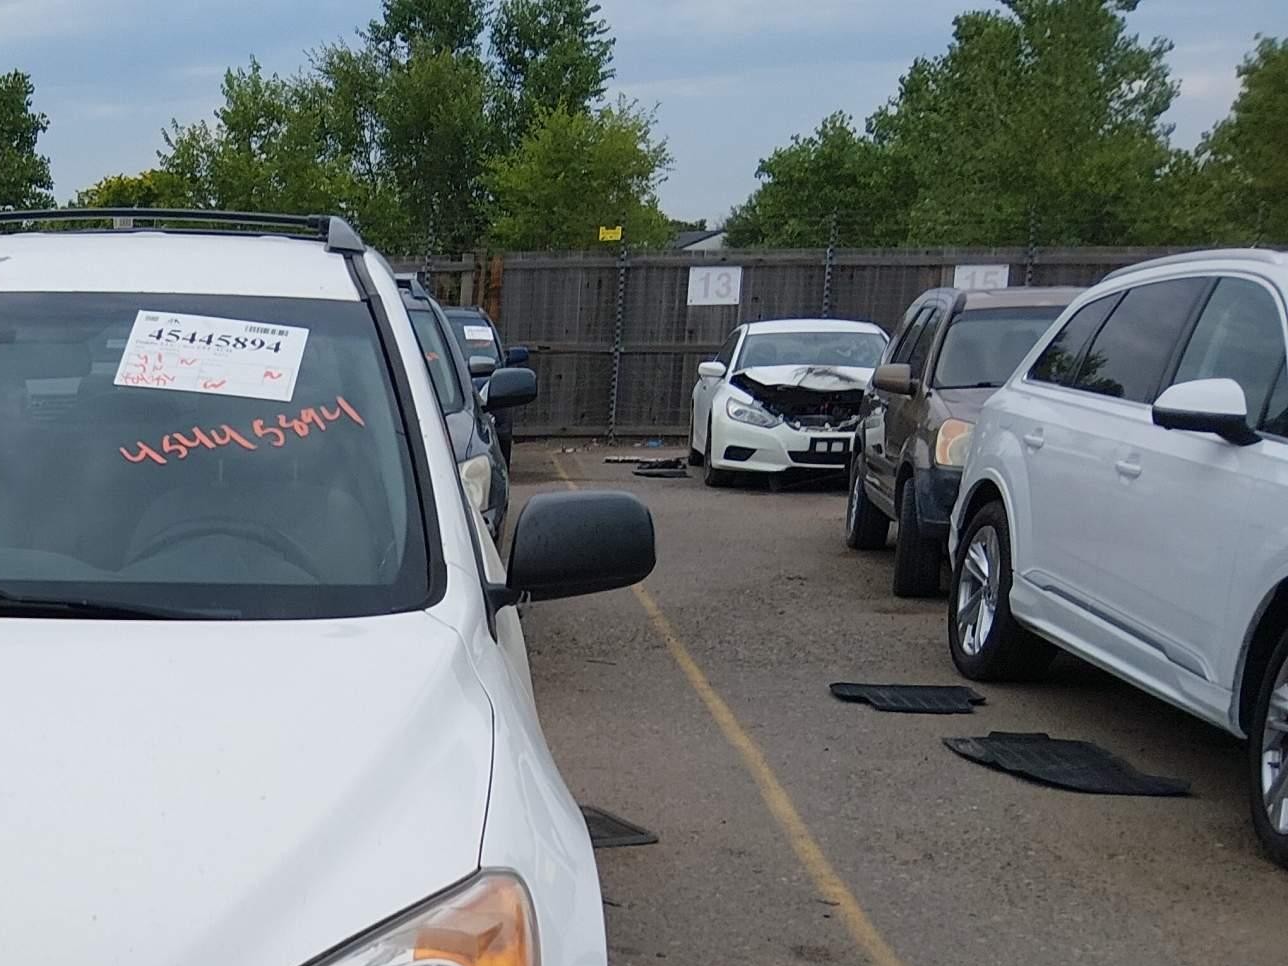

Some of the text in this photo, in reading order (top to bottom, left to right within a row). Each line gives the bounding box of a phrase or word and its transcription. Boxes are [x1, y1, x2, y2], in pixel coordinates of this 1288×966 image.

[698, 271, 732, 299] 13
[148, 327, 283, 354] 45445894
[119, 396, 366, 464] 45445894
